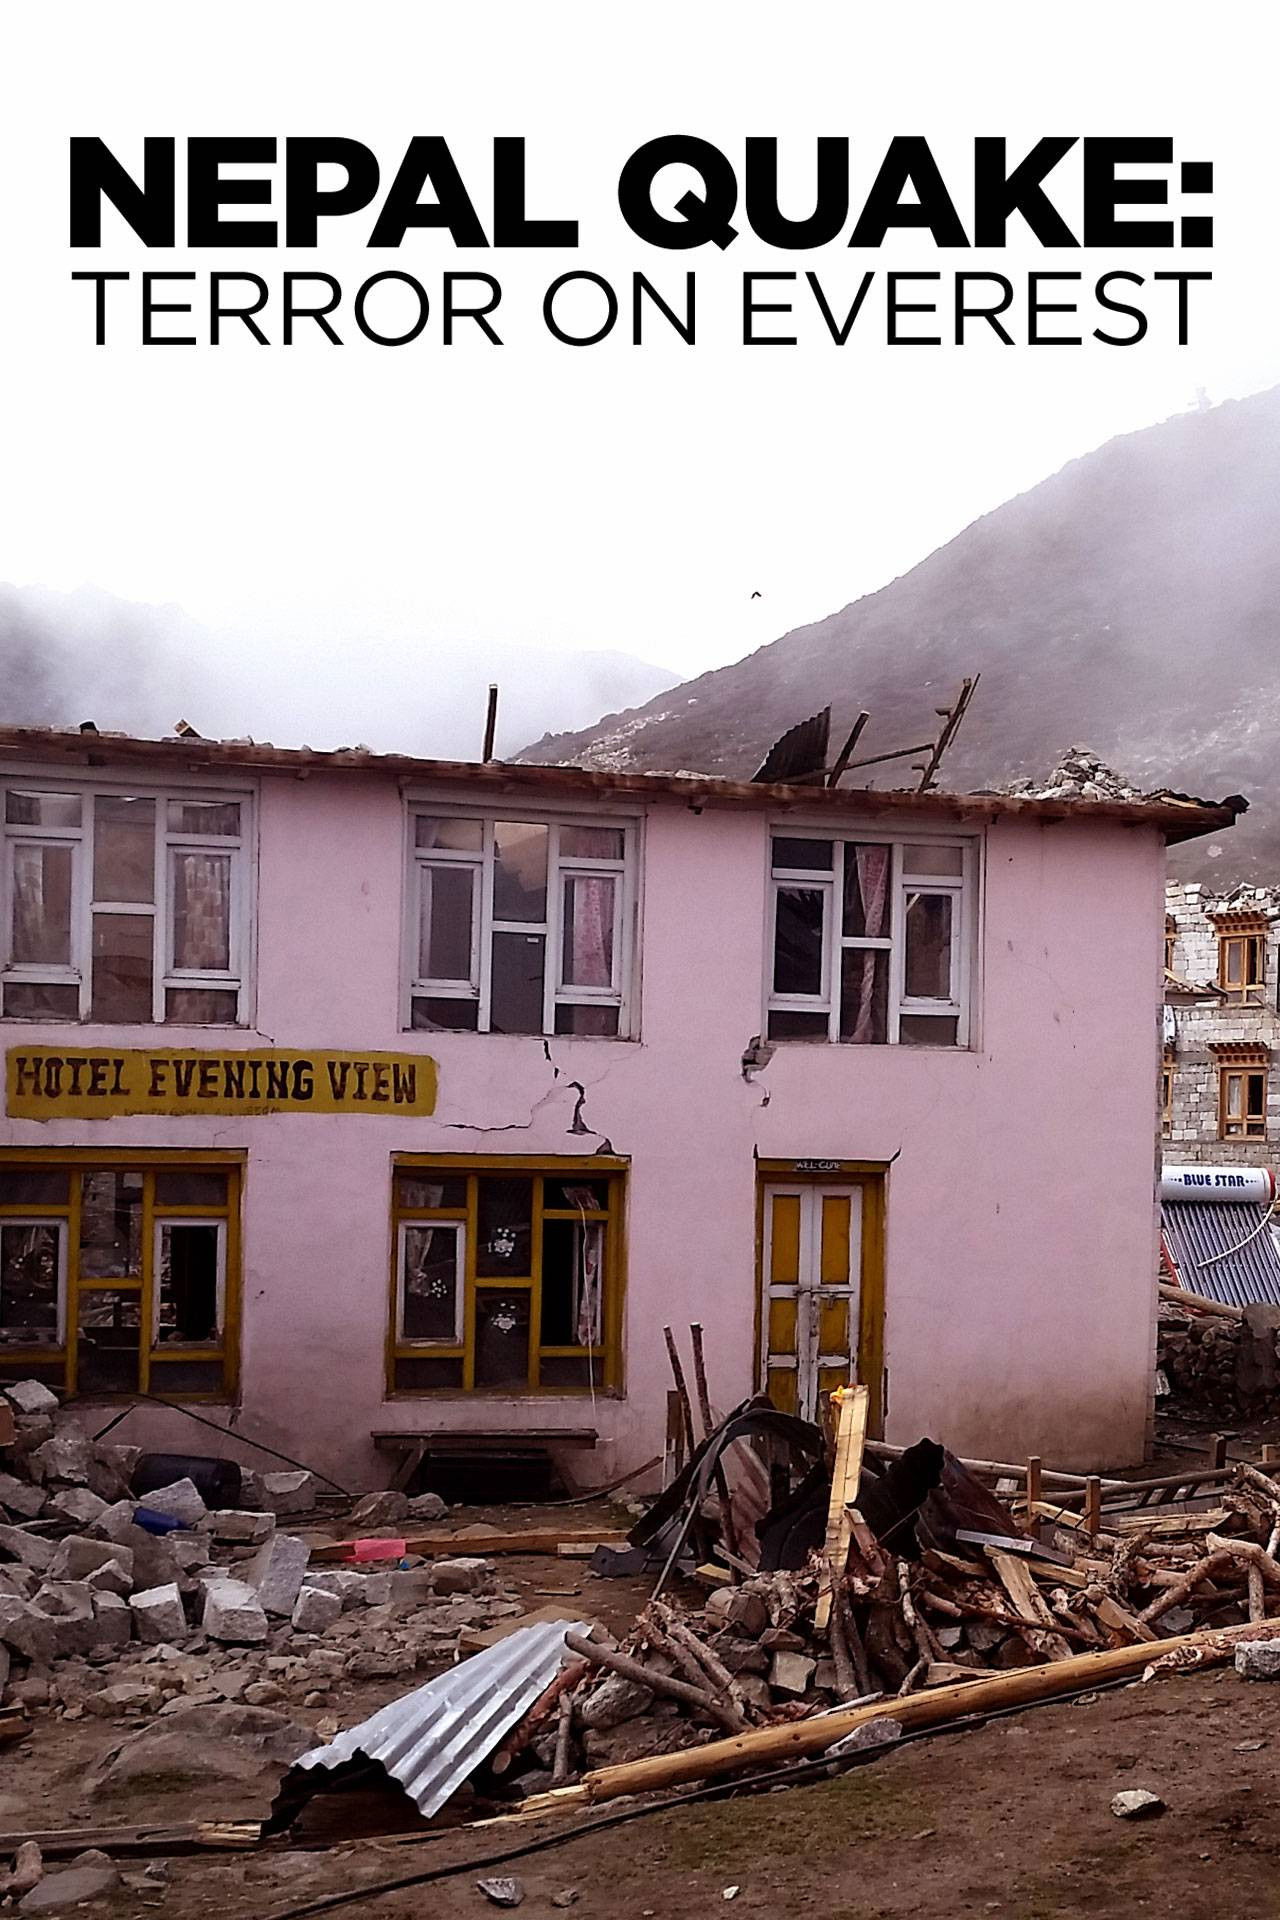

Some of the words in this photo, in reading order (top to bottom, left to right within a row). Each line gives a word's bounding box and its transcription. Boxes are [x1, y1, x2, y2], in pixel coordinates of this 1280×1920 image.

[15, 1056, 130, 1098] HOTEL
[148, 1059, 314, 1101] EVENING
[327, 1061, 416, 1104] VIEW
[1183, 1173, 1212, 1186] BLUE
[1214, 1174, 1245, 1187] STAR
